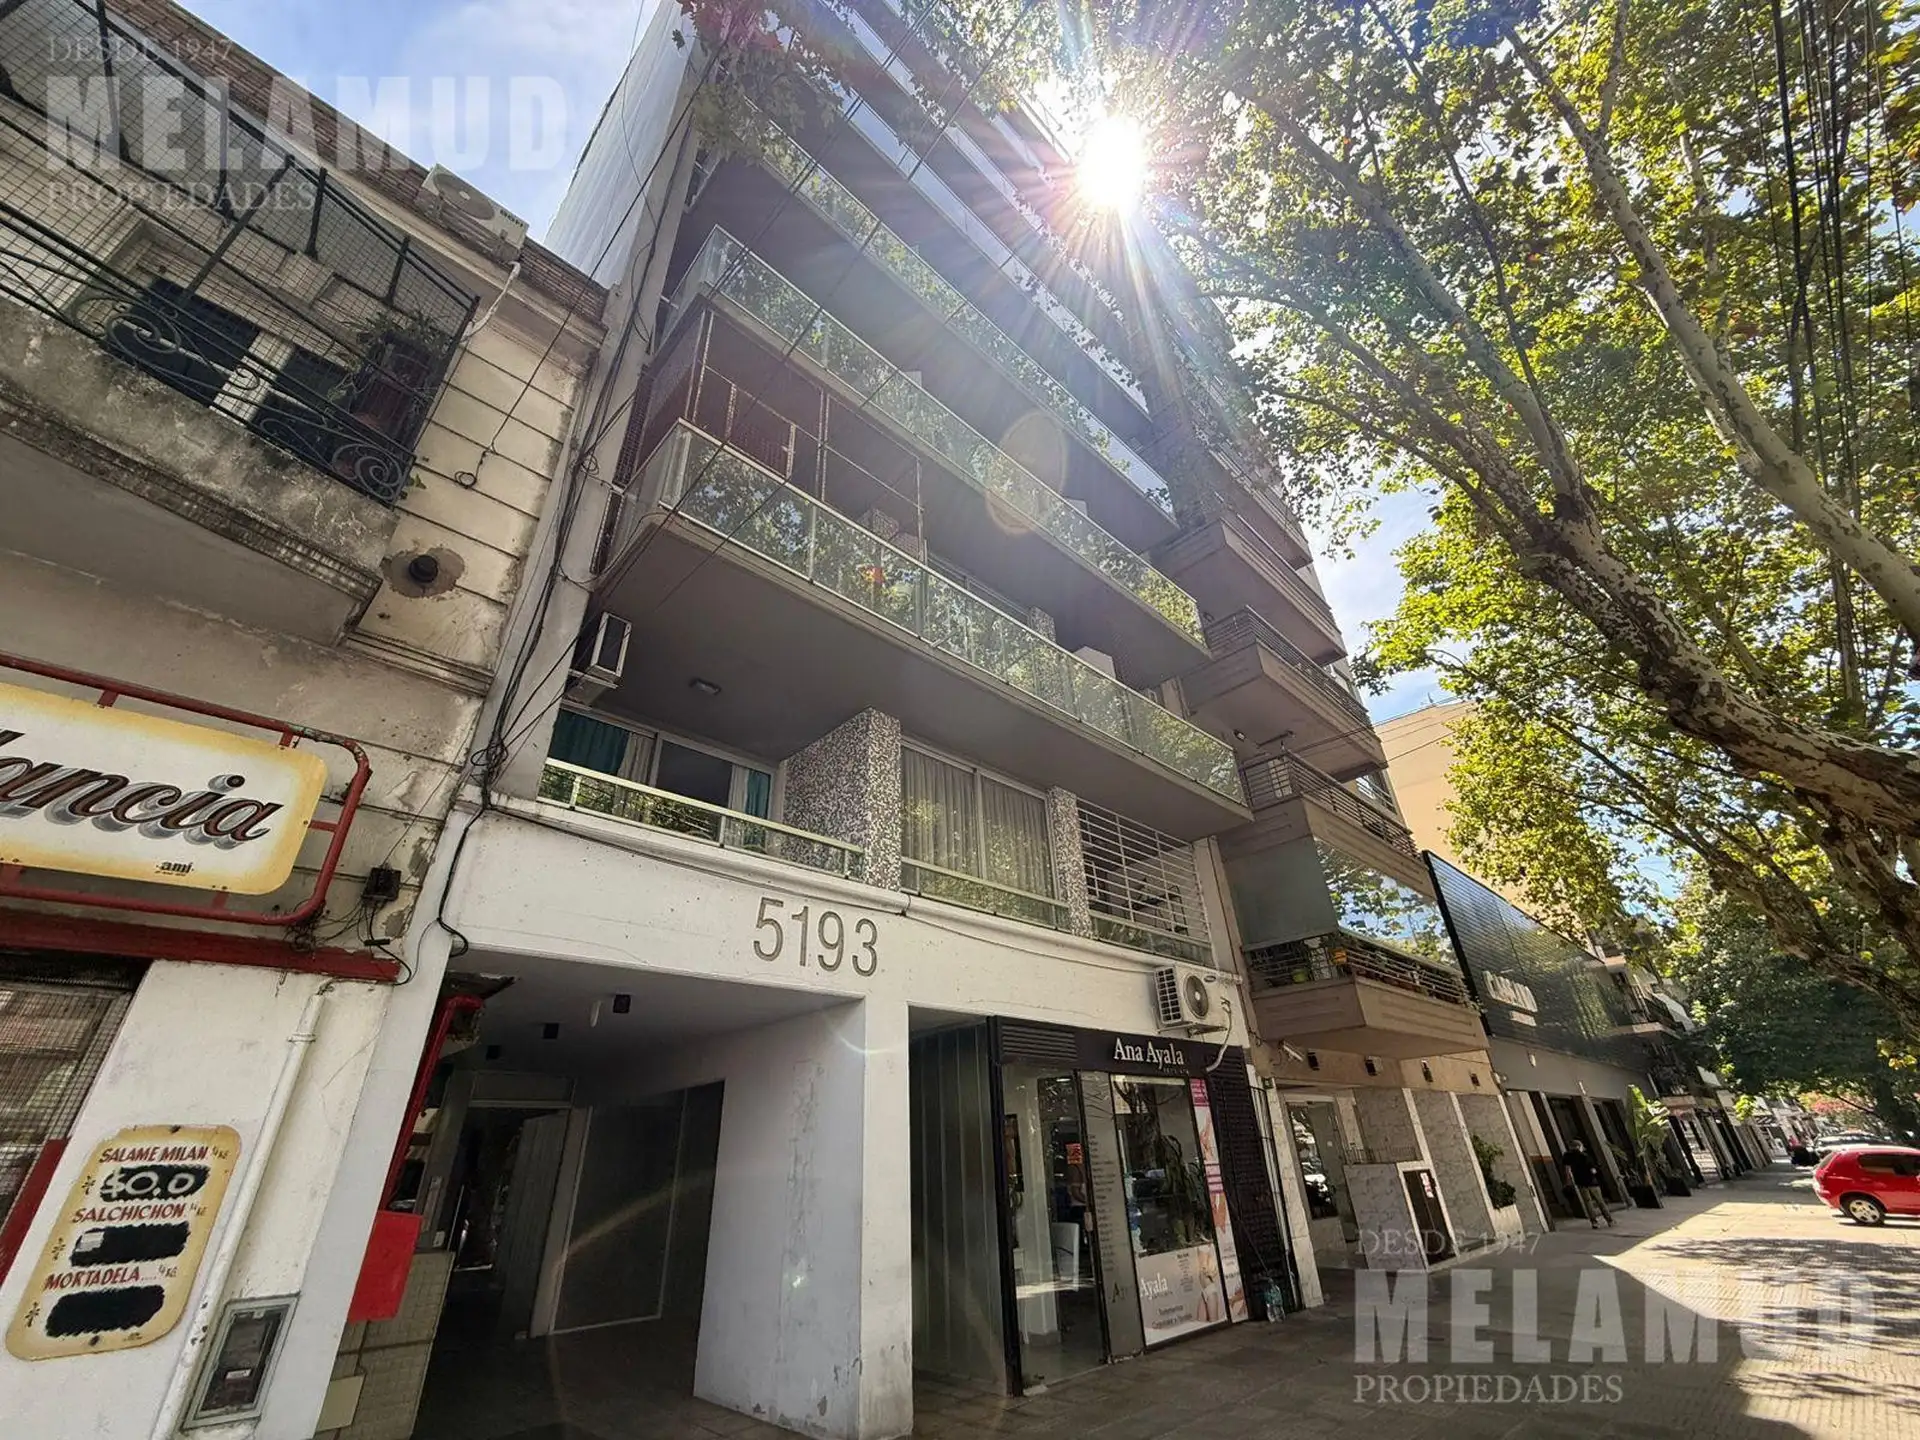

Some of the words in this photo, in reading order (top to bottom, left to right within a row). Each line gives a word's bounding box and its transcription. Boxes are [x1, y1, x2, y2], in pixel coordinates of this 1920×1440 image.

[753, 896, 878, 977] 5193
[1113, 1037, 1144, 1062] Ana
[1146, 1040, 1184, 1070] Ayala
[99, 1146, 157, 1163] SALAME
[158, 1145, 209, 1161] MILAN
[72, 1202, 187, 1223] SALCHICHON
